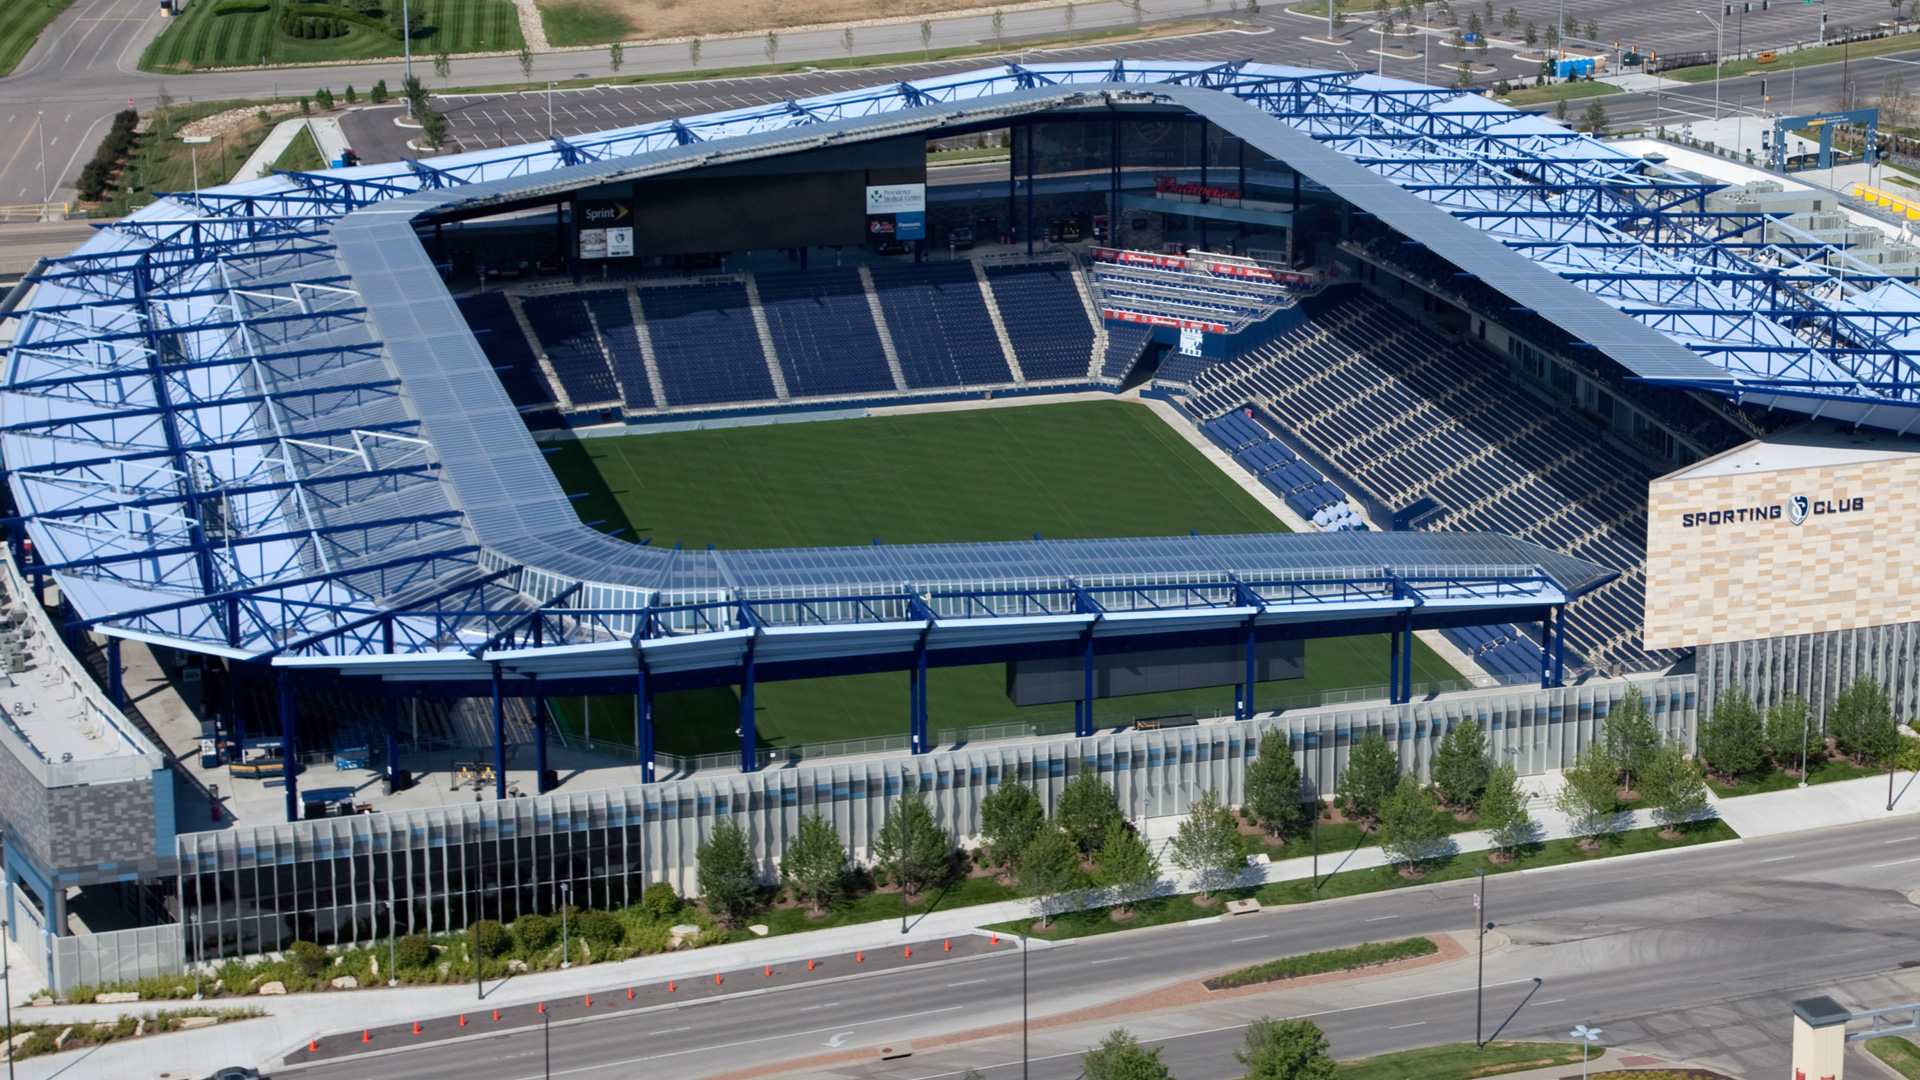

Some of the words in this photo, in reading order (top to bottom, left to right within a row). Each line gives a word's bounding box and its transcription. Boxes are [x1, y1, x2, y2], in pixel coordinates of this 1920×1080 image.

[585, 208, 615, 221] Sprint
[1682, 505, 1782, 528] SPORTING
[1813, 497, 1864, 515] CLUB
